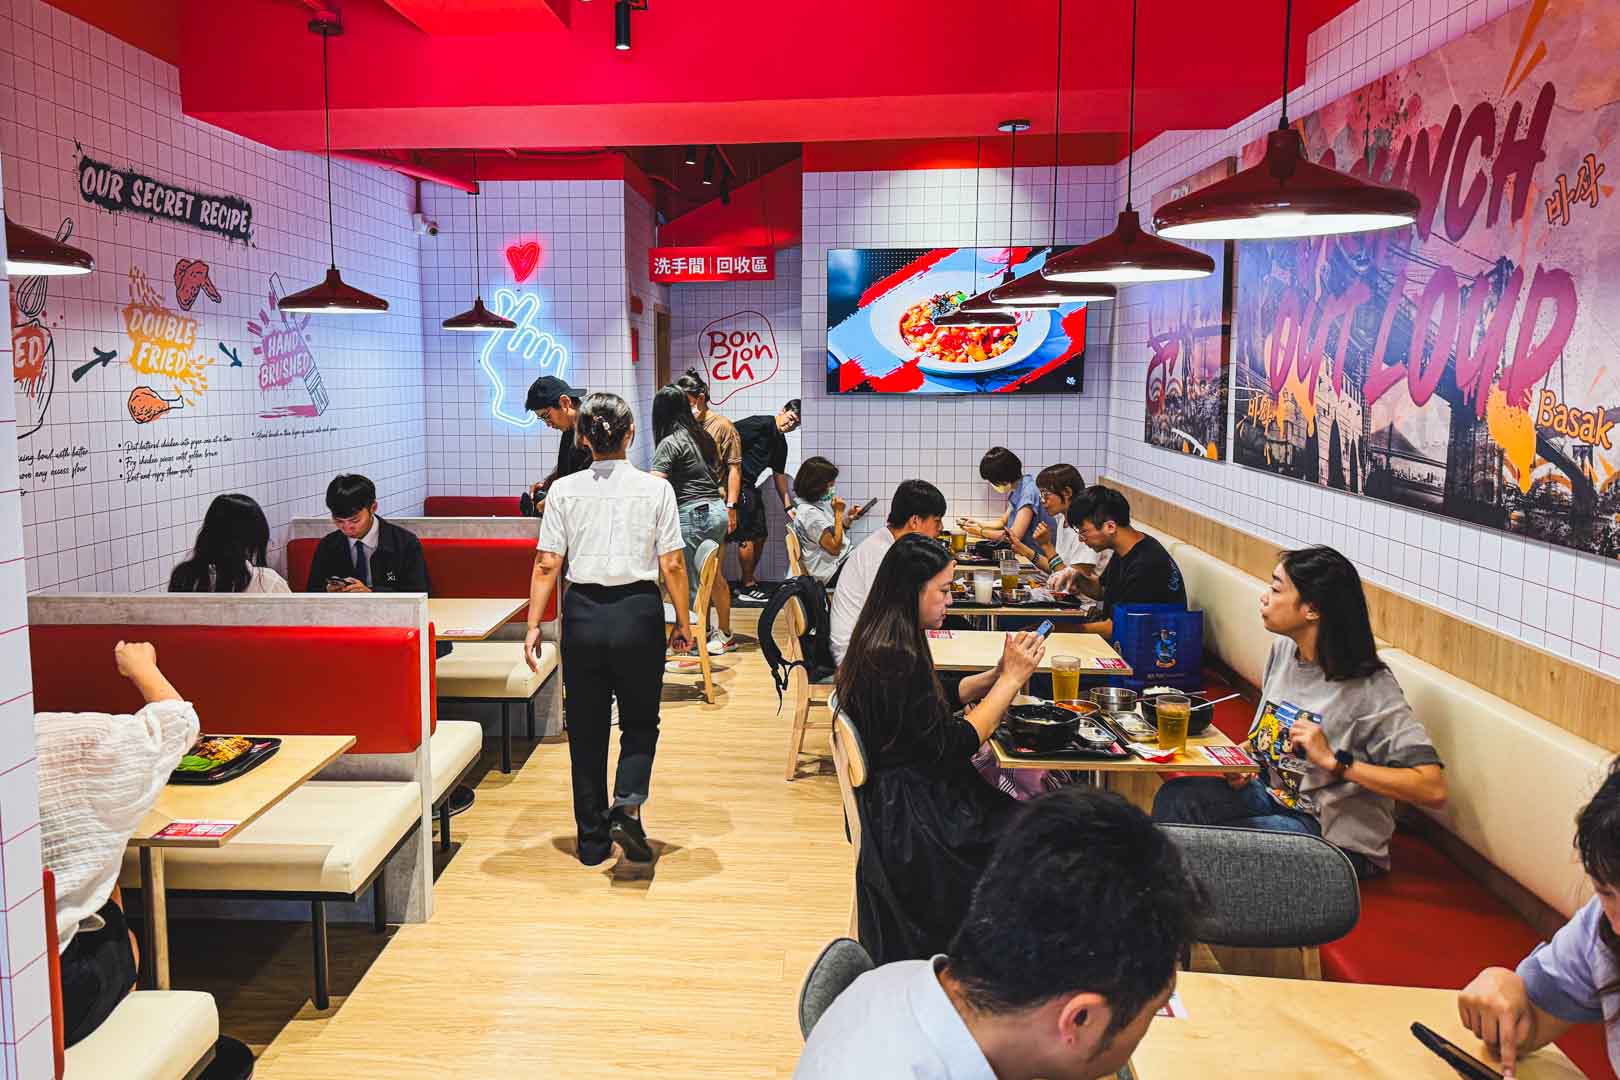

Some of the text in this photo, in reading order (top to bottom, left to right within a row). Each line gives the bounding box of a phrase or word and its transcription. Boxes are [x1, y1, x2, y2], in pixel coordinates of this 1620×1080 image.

[82, 167, 249, 233] OUR SECRET RECIPE
[1545, 154, 1605, 226] 바삭
[653, 256, 768, 275] 洗手間 回收區
[129, 308, 194, 344] DOUBLE
[1269, 281, 1371, 408] OUT
[1362, 265, 1577, 420] LOUD
[136, 341, 188, 373] FRIED
[268, 331, 300, 358] HAND
[261, 351, 310, 387] BRUSHED
[1536, 388, 1614, 450] Basak
